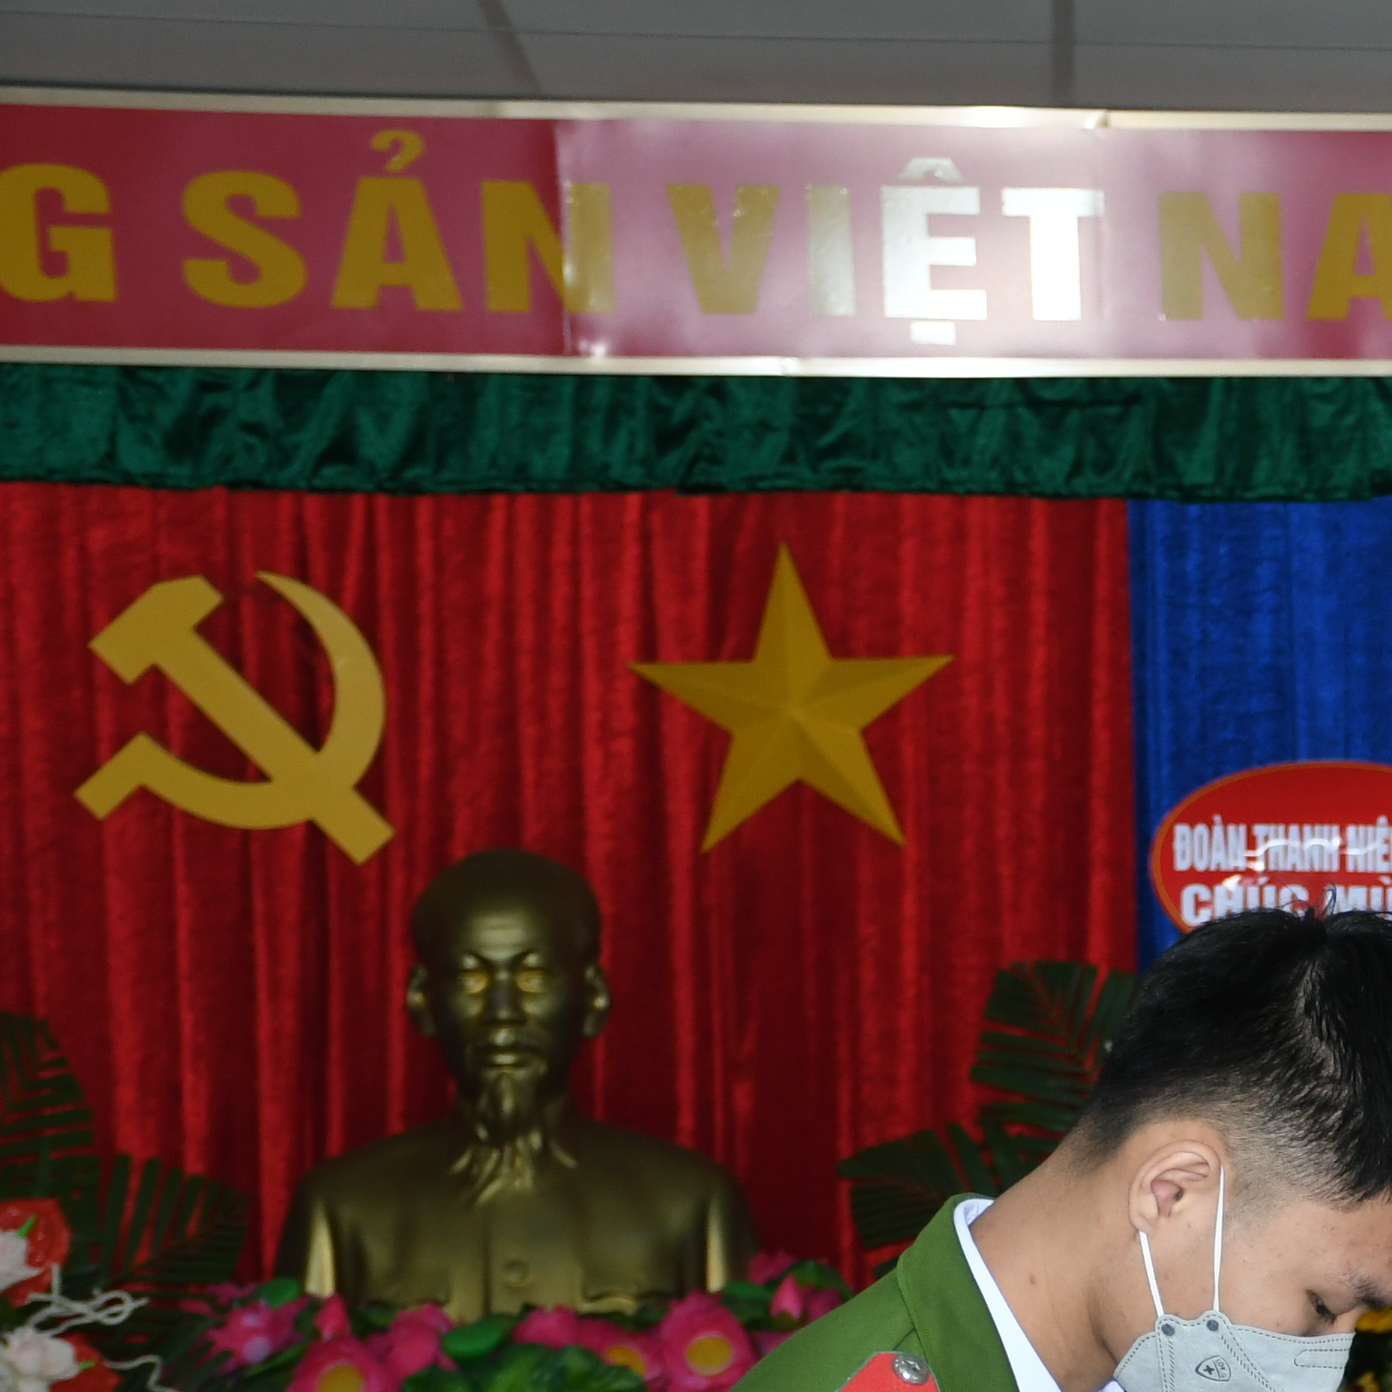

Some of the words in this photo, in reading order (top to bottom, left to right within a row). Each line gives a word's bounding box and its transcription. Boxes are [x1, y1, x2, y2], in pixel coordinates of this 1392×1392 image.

[182, 129, 615, 313] SẢN
[667, 156, 1104, 345] VIỆT
[1173, 814, 1247, 872] ĐOÀN
[1252, 824, 1340, 872] THANH
